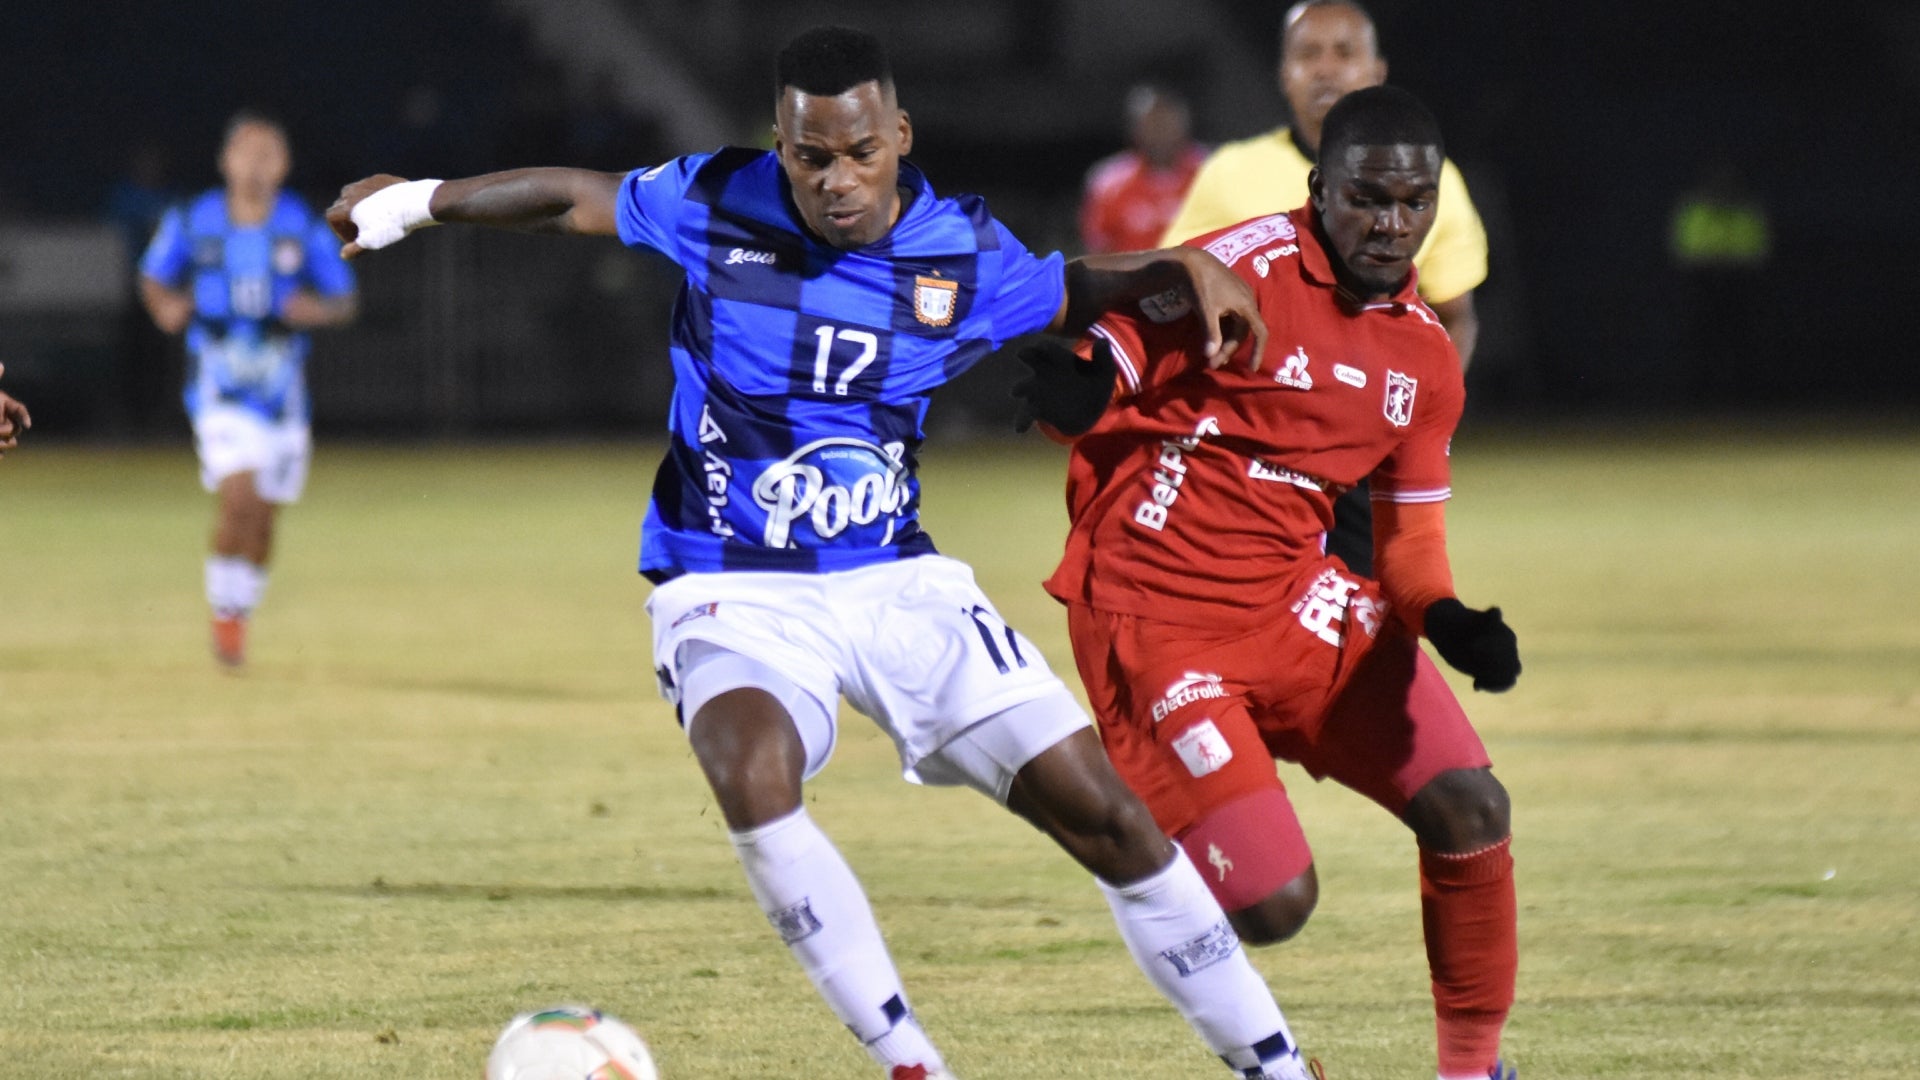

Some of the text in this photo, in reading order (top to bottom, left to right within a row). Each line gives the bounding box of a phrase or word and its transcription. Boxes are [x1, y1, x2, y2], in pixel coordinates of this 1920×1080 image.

[813, 325, 878, 396] 17
[961, 604, 1028, 675] 17
[1152, 682, 1224, 722] Electrolit
